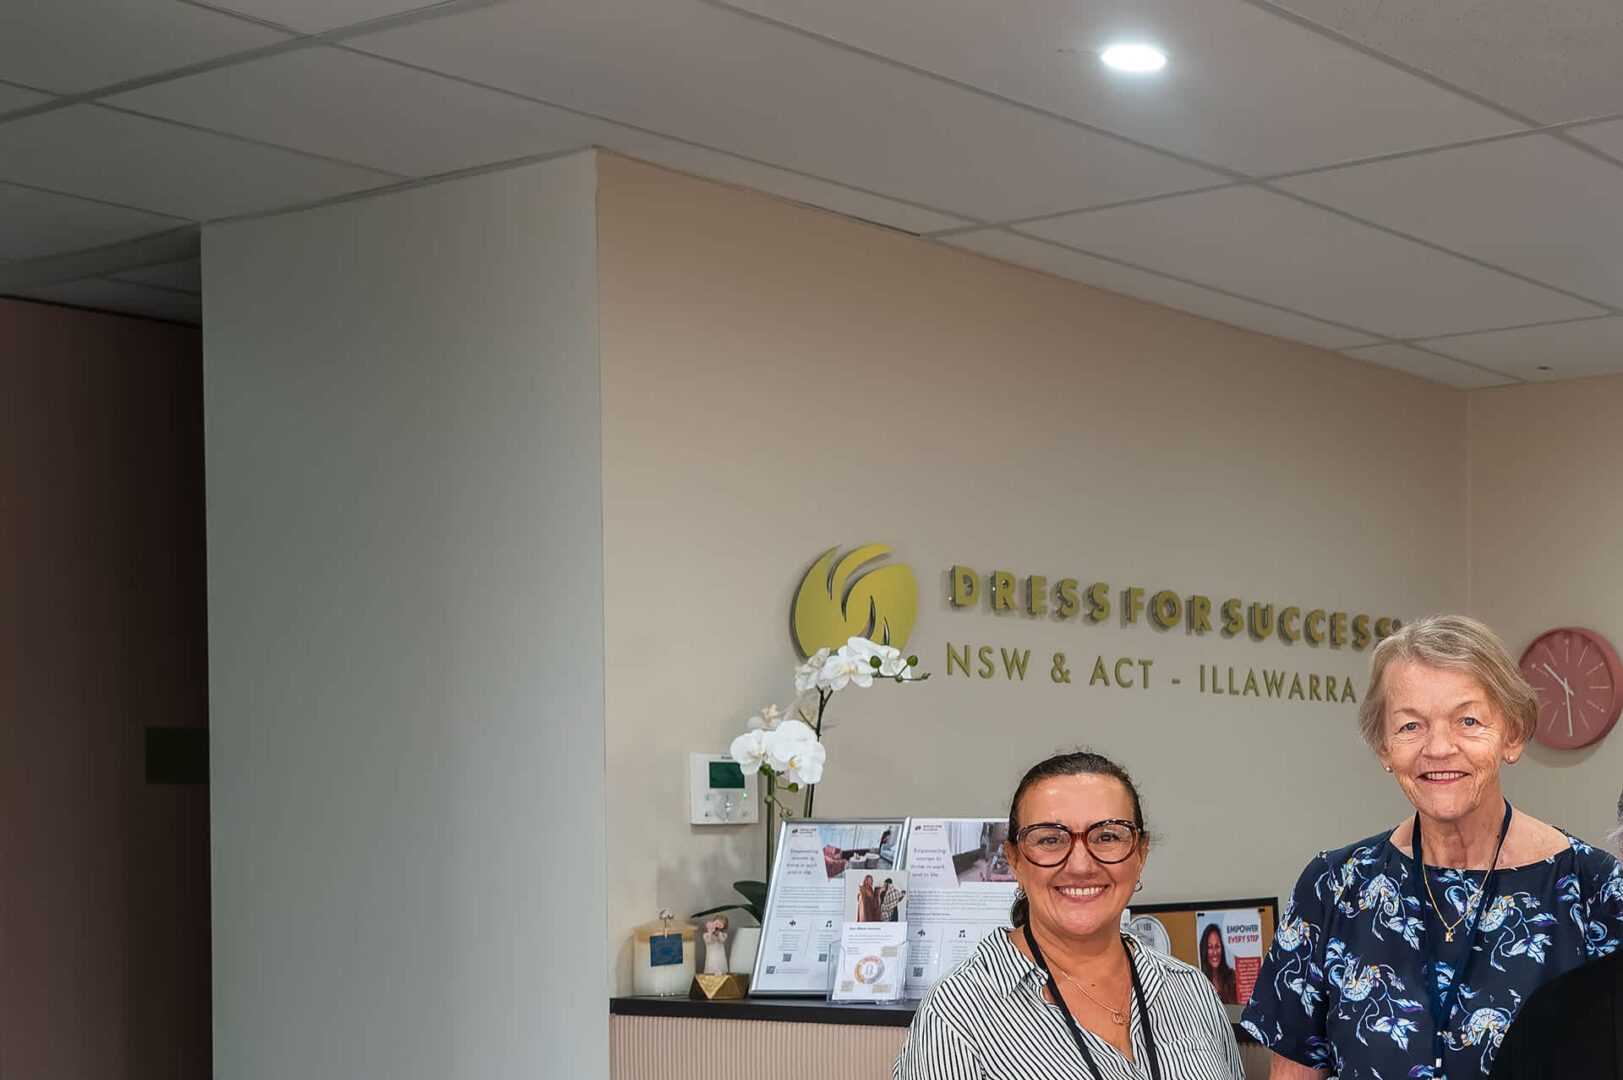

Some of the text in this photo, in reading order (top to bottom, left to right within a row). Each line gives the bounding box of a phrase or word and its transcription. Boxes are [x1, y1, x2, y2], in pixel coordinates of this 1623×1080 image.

[951, 565, 1111, 621] DRESS
[1128, 587, 1212, 632] FOR
[946, 642, 1031, 681] NSW
[1051, 652, 1071, 684] &
[1089, 655, 1154, 690] ACT
[1199, 664, 1357, 704] ILLAWARRA
[1226, 924, 1259, 934] EMPOWER
[1228, 934, 1259, 944] EVERY STEP
